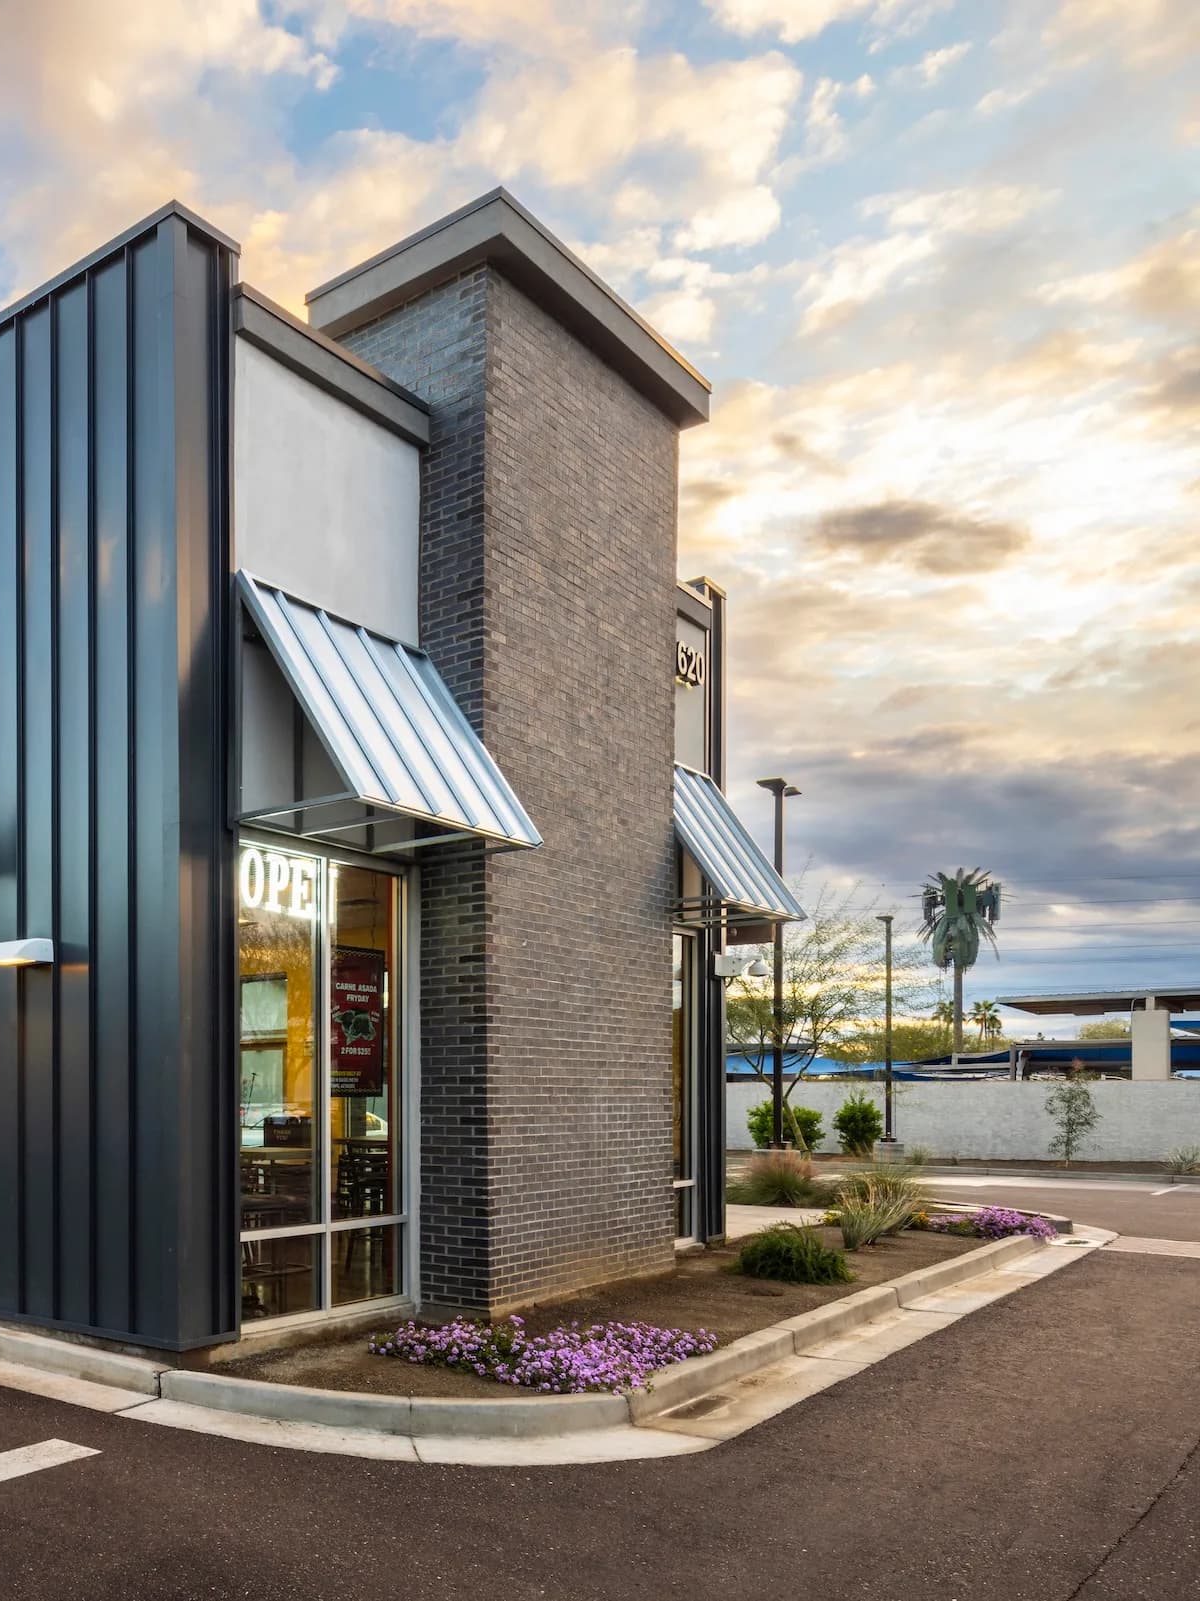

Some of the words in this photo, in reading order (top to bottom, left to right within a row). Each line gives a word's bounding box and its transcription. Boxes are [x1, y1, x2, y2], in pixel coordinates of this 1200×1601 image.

[678, 640, 705, 686] 620
[335, 982, 356, 991] CARNE
[358, 984, 377, 993] ASADA
[346, 993, 369, 1003] FRYDAY
